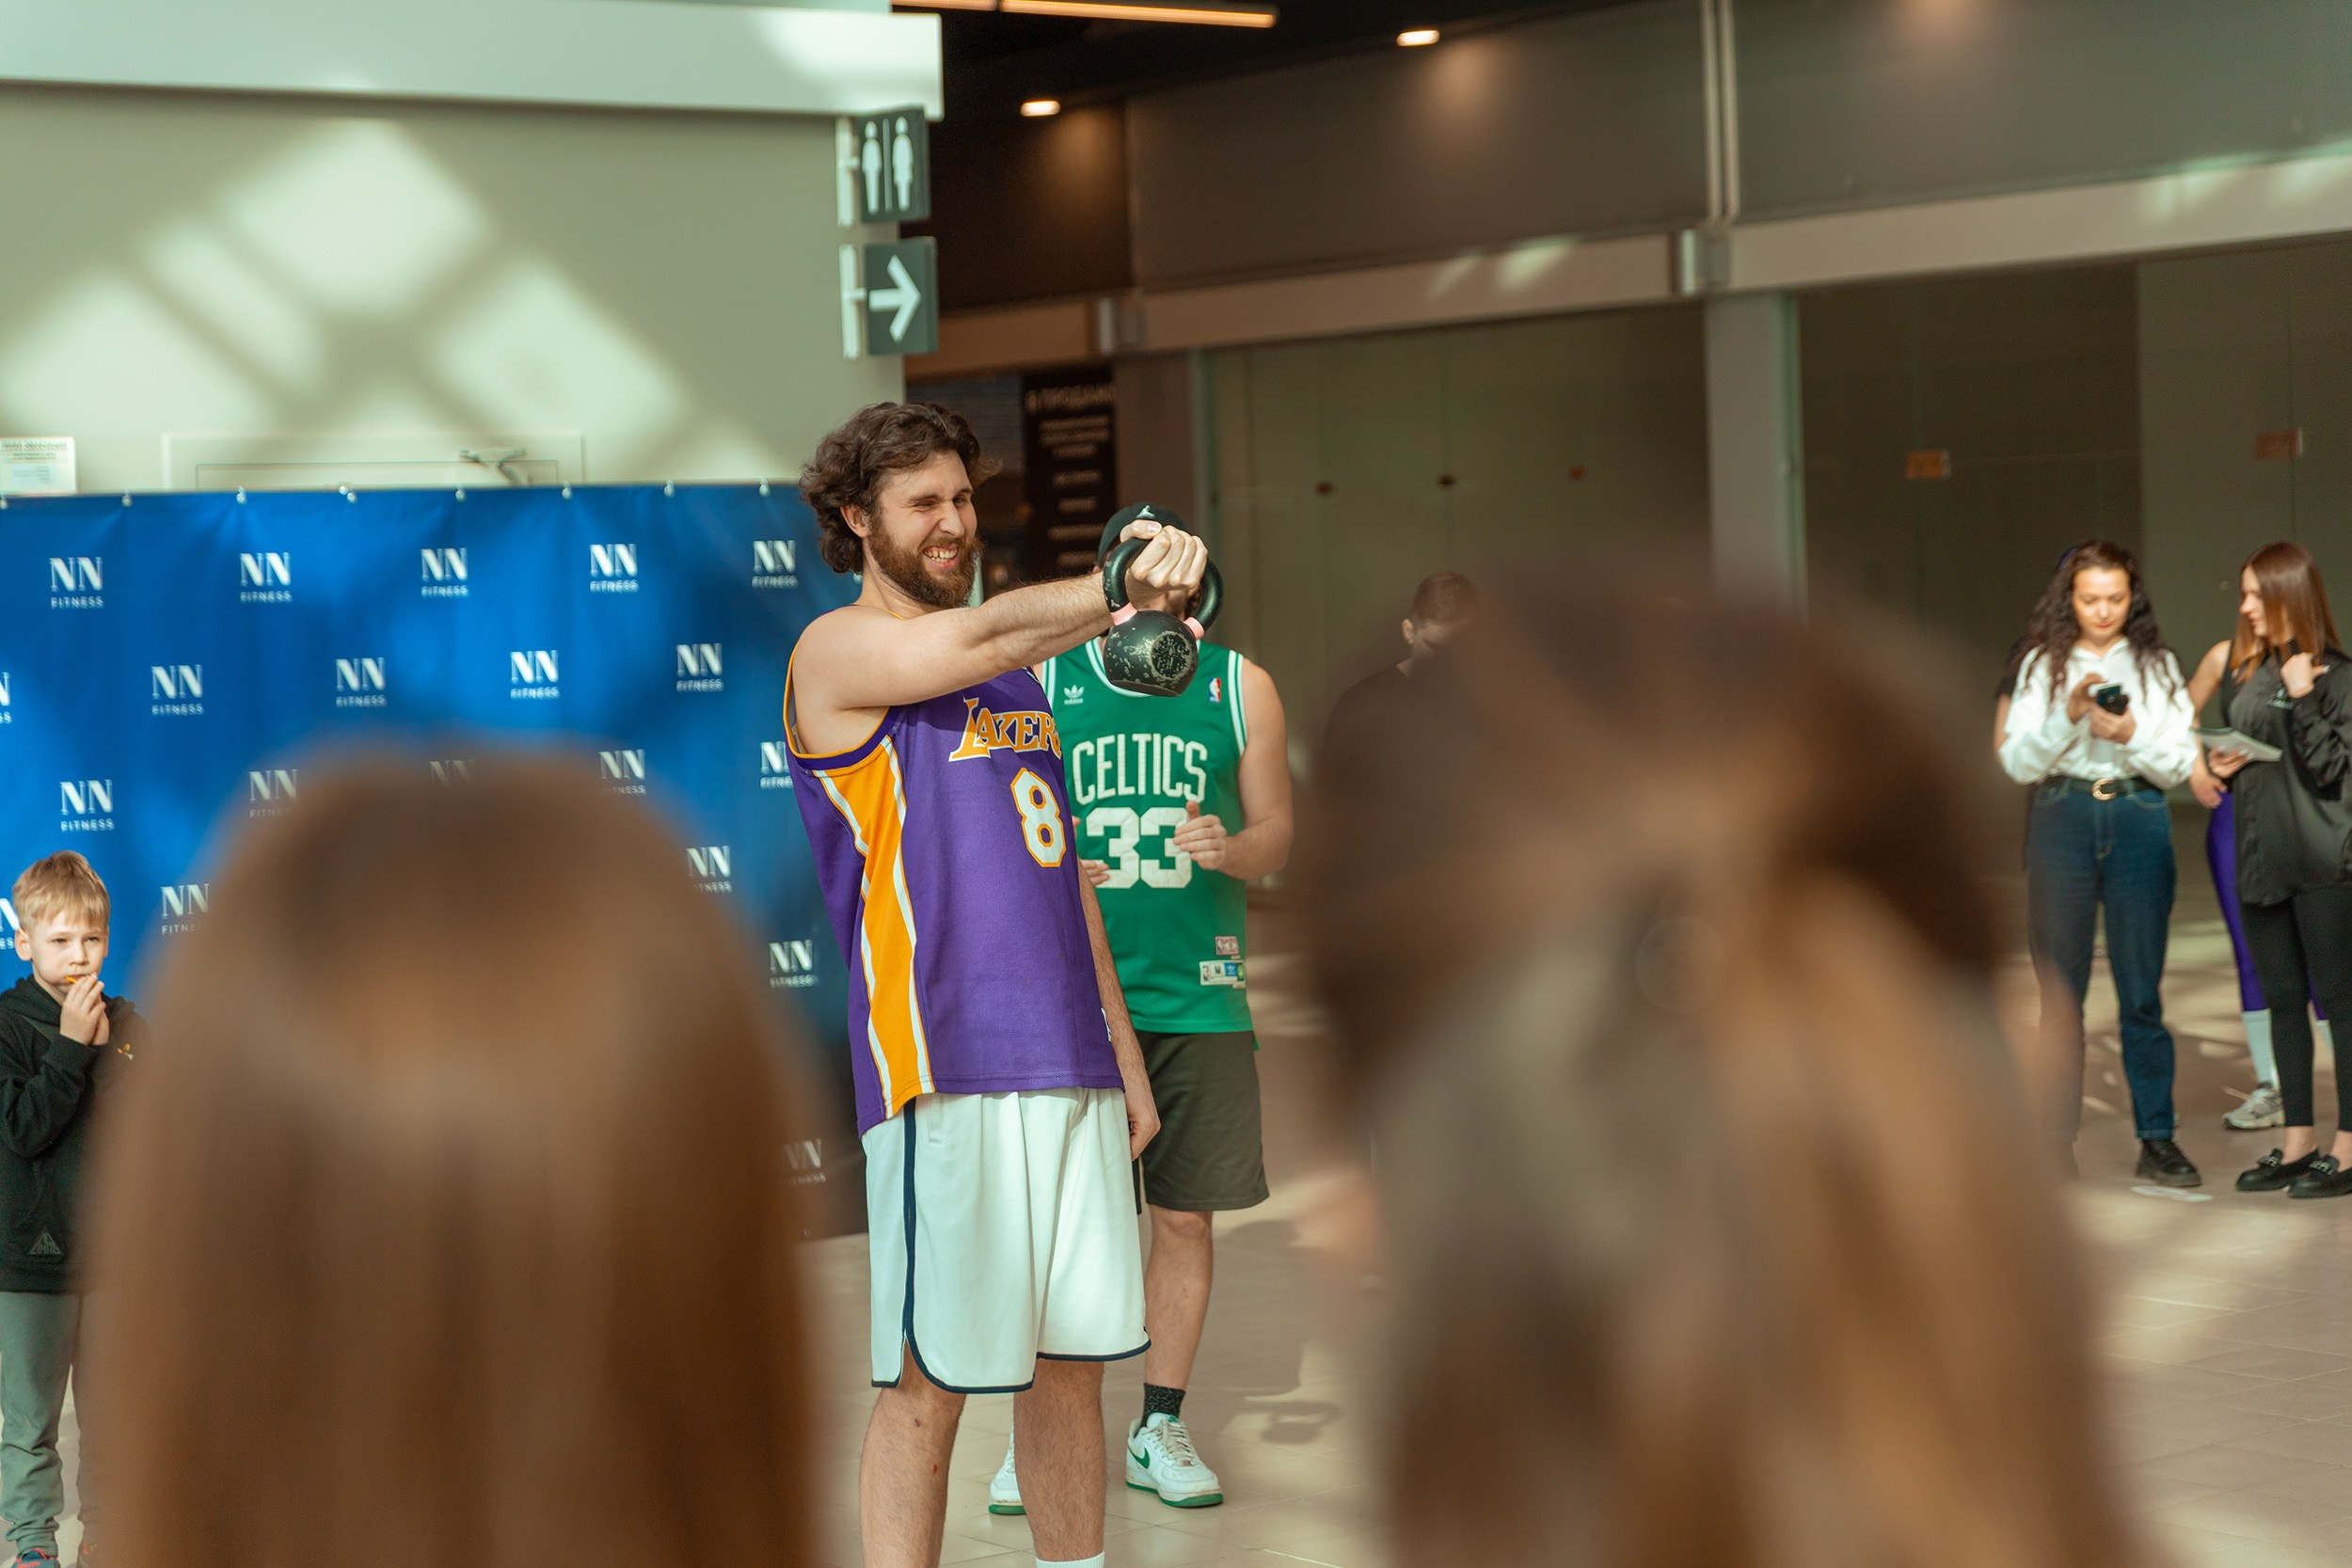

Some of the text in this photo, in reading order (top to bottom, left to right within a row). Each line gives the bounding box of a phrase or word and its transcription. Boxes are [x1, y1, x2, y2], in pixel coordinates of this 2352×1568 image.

[240, 552, 292, 587] NN
[421, 547, 468, 581] NN
[590, 543, 638, 578] NN
[753, 540, 797, 574] NN
[49, 557, 103, 592] NN
[421, 584, 469, 597] FITNESS
[590, 579, 639, 594] FITNESS
[752, 575, 799, 589] FITNESS
[51, 595, 104, 609] FITNESS
[240, 590, 292, 603] FITNESS
[336, 657, 386, 691] NN
[510, 650, 560, 684] NN
[676, 643, 723, 677] NN
[151, 664, 203, 699] NN
[510, 686, 561, 700] FITNESS
[676, 679, 724, 693] FITNESS
[152, 703, 204, 716] FITNESS
[336, 694, 387, 708] FITNESS
[598, 749, 646, 780] NN
[760, 741, 788, 774] N
[1073, 733, 1208, 806] CELTICS
[60, 779, 113, 816] NN
[248, 768, 298, 800] NN
[760, 776, 793, 790] FITNE
[60, 817, 115, 832] FITNESS
[249, 807, 288, 817] FITNE
[1010, 767, 1067, 867] 8
[686, 846, 731, 878] NN
[1081, 807, 1192, 888] 33
[161, 883, 210, 919] NN
[162, 924, 197, 935] FITNE
[769, 940, 813, 974] NN
